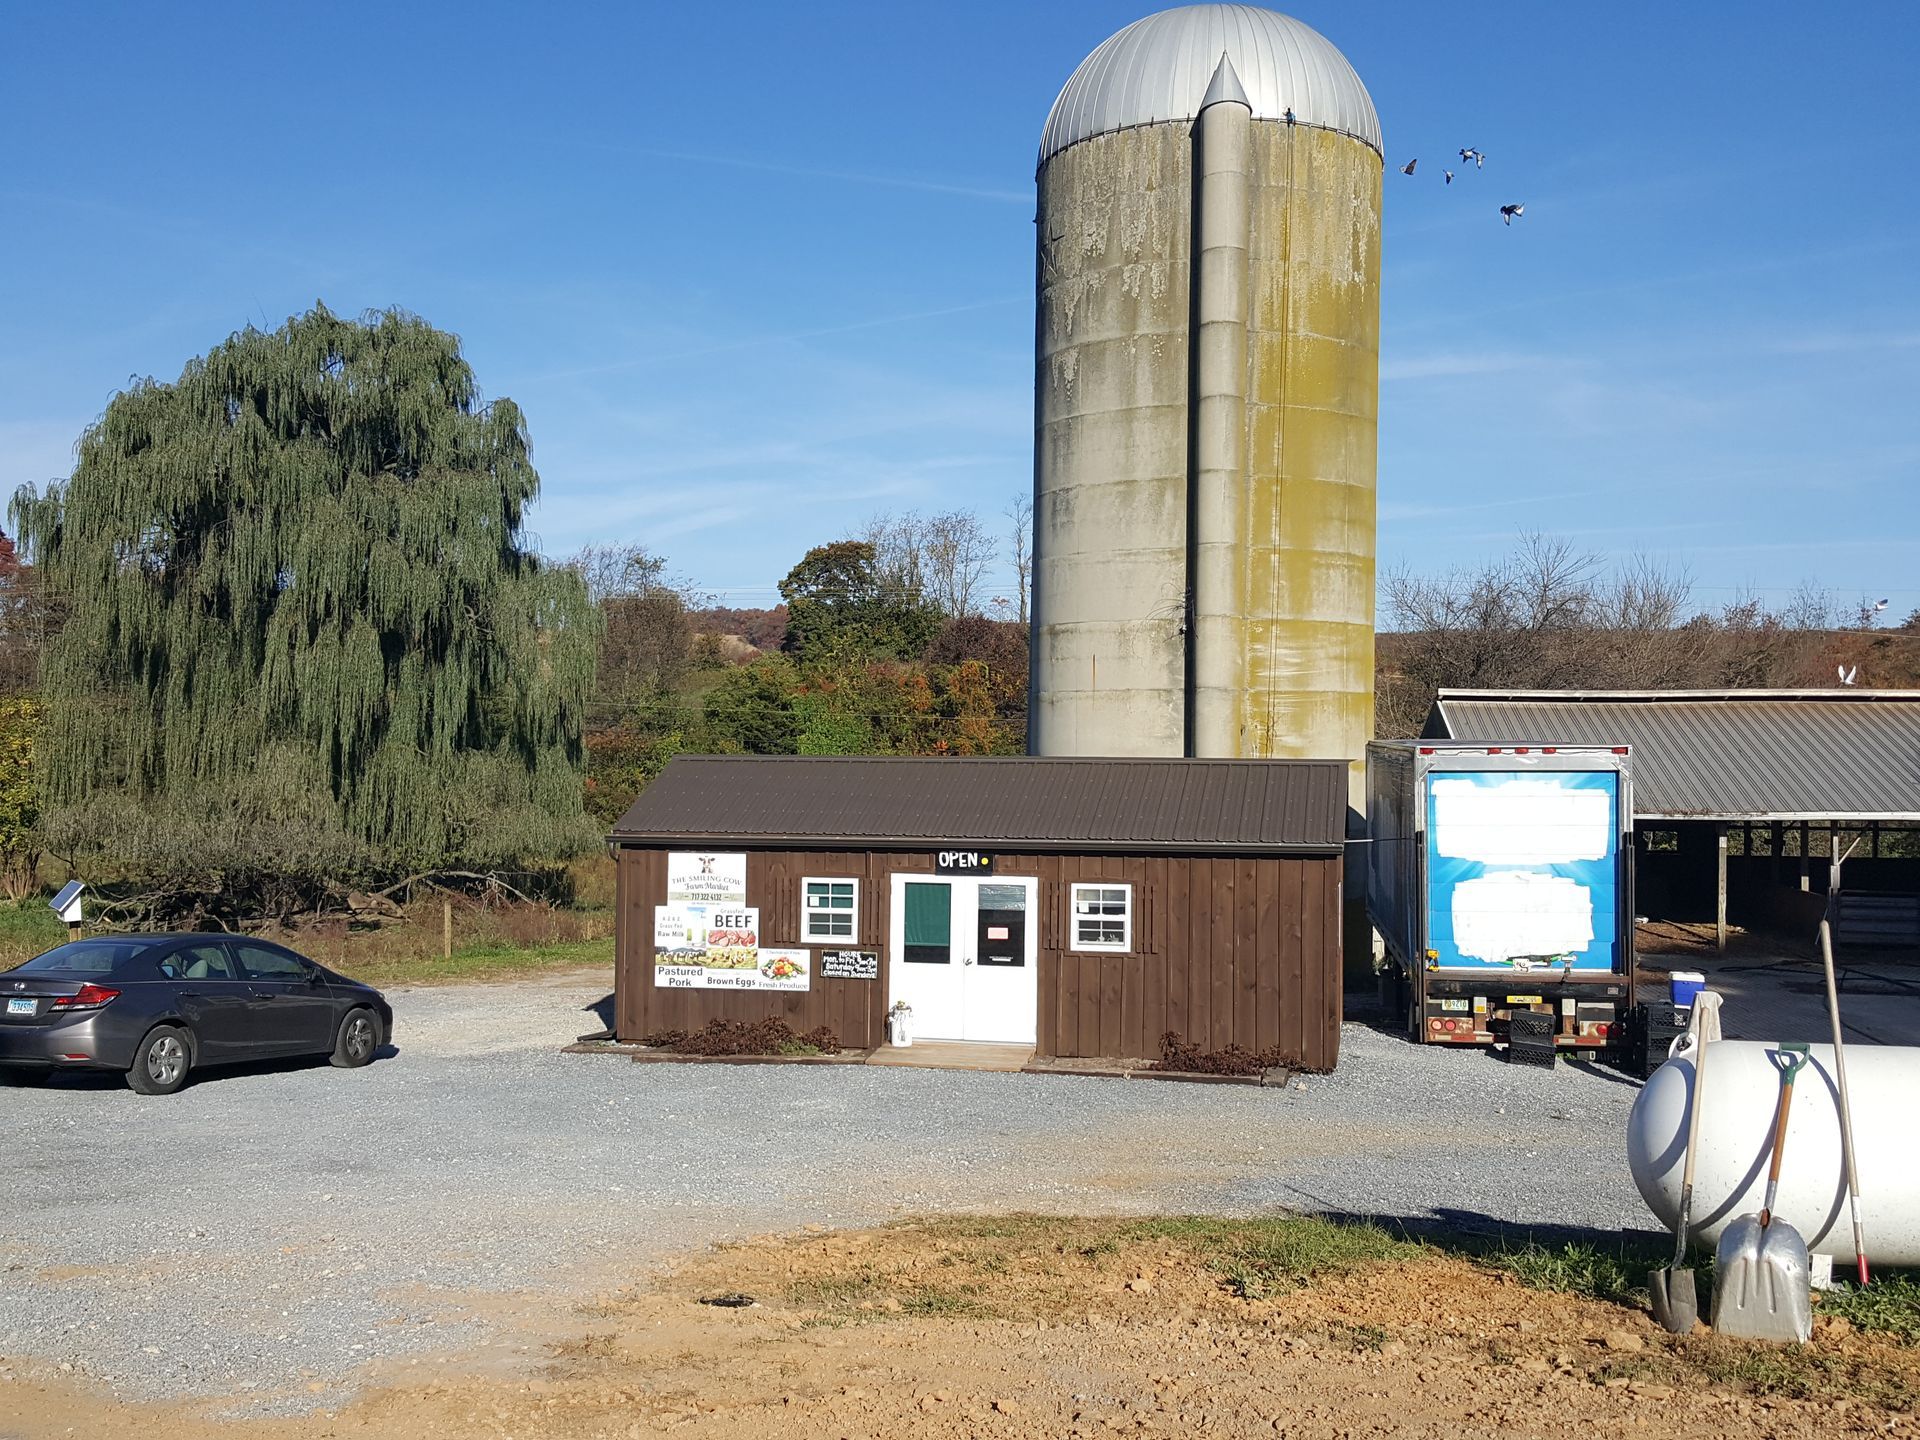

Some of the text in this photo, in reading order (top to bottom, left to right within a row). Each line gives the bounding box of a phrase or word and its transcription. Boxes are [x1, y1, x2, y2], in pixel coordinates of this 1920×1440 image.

[939, 851, 978, 867] OPEN
[672, 876, 686, 884] THE
[723, 877, 742, 885] COW
[684, 882, 729, 891] Farm Market
[701, 893, 709, 901] 322
[715, 914, 752, 928] BEEF
[658, 966, 703, 976] Pastured
[826, 962, 854, 971] Saturday
[668, 977, 692, 987] Pork
[707, 976, 756, 988] Brown Eggs
[779, 982, 808, 990] Produce
